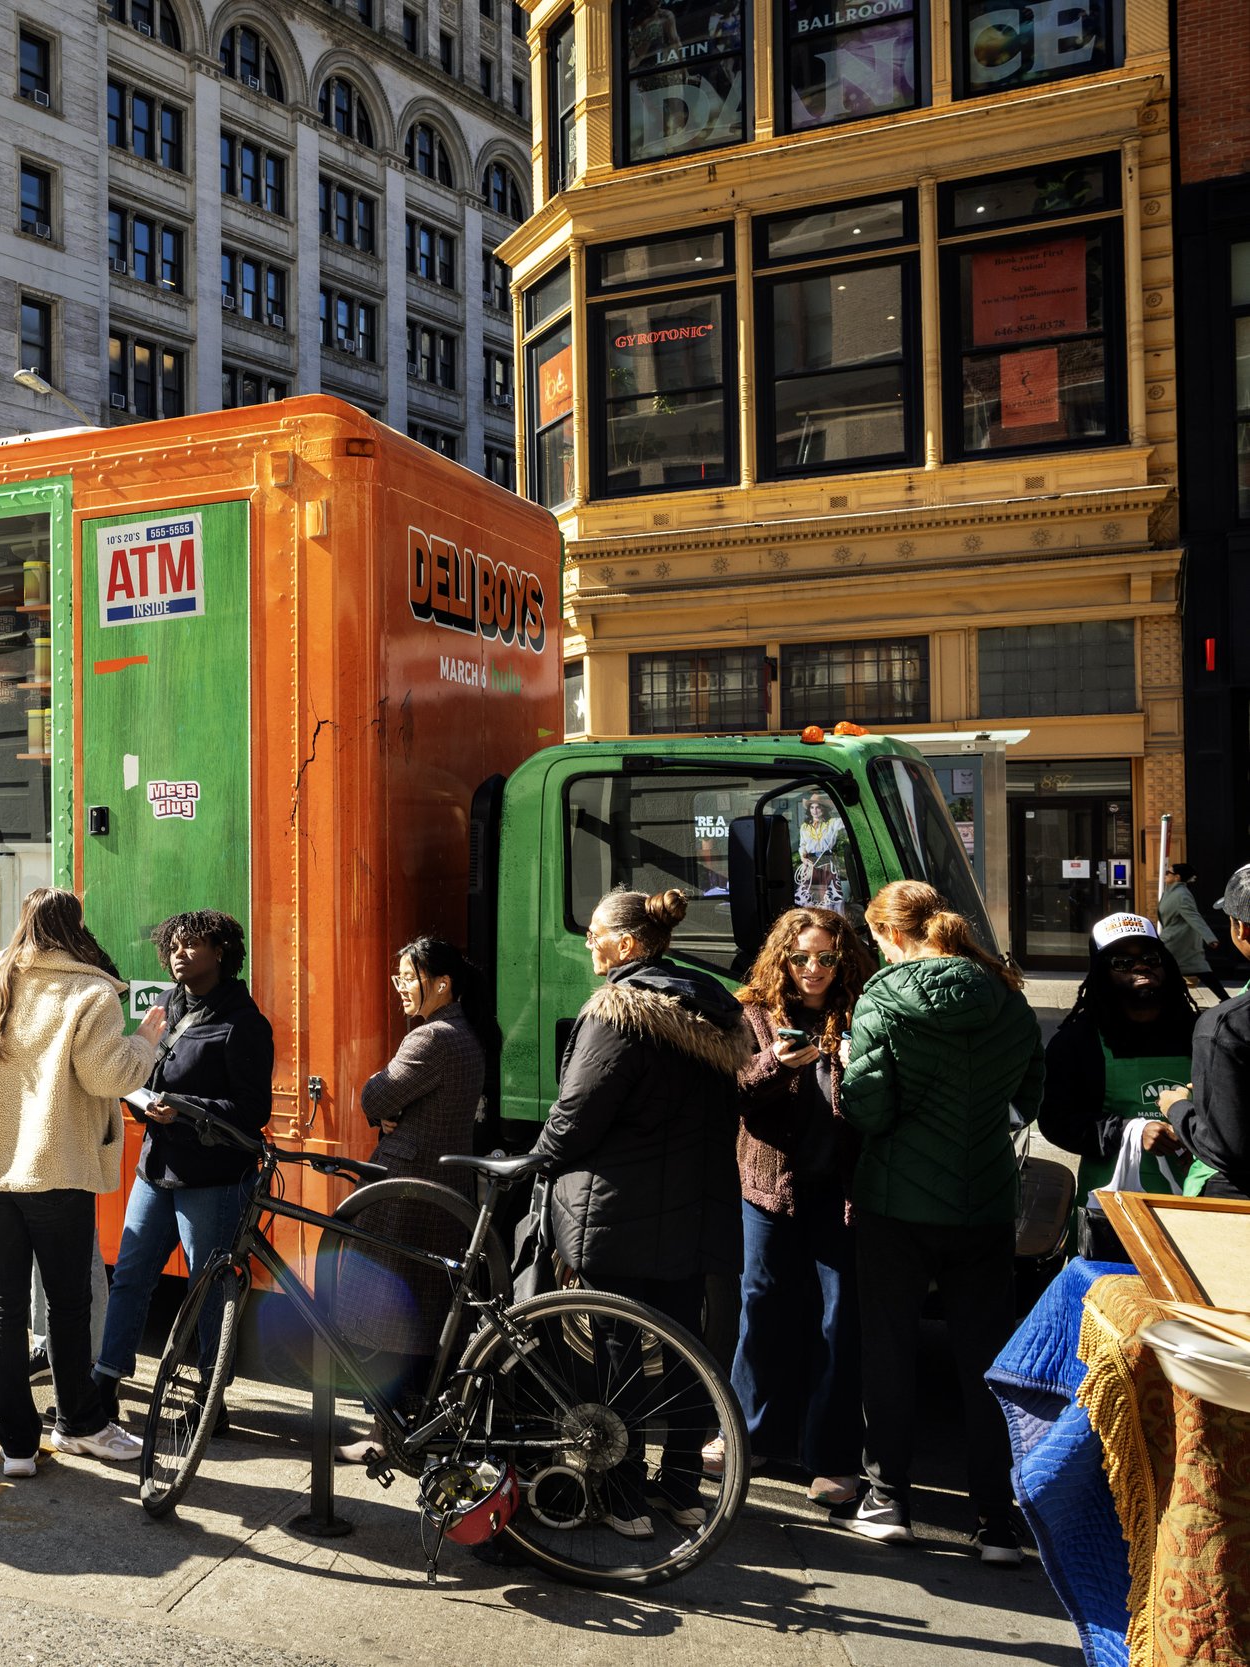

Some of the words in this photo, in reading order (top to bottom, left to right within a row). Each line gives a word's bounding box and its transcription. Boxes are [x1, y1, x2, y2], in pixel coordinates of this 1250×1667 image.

[798, 0, 904, 33] BALLROOM
[657, 41, 708, 64] LATIN
[1043, 249, 1064, 258] First
[150, 523, 190, 539] 555-5555
[107, 539, 196, 602] ATM
[409, 526, 476, 632] DELI
[477, 553, 546, 654] BOYS
[132, 600, 170, 618] INSIDE
[440, 655, 479, 687] MARCH
[480, 665, 487, 688] 6
[491, 657, 521, 695] hulu
[1040, 773, 1074, 790] 857
[149, 782, 199, 800] Mega
[155, 800, 194, 817] Glug
[715, 815, 726, 826] A
